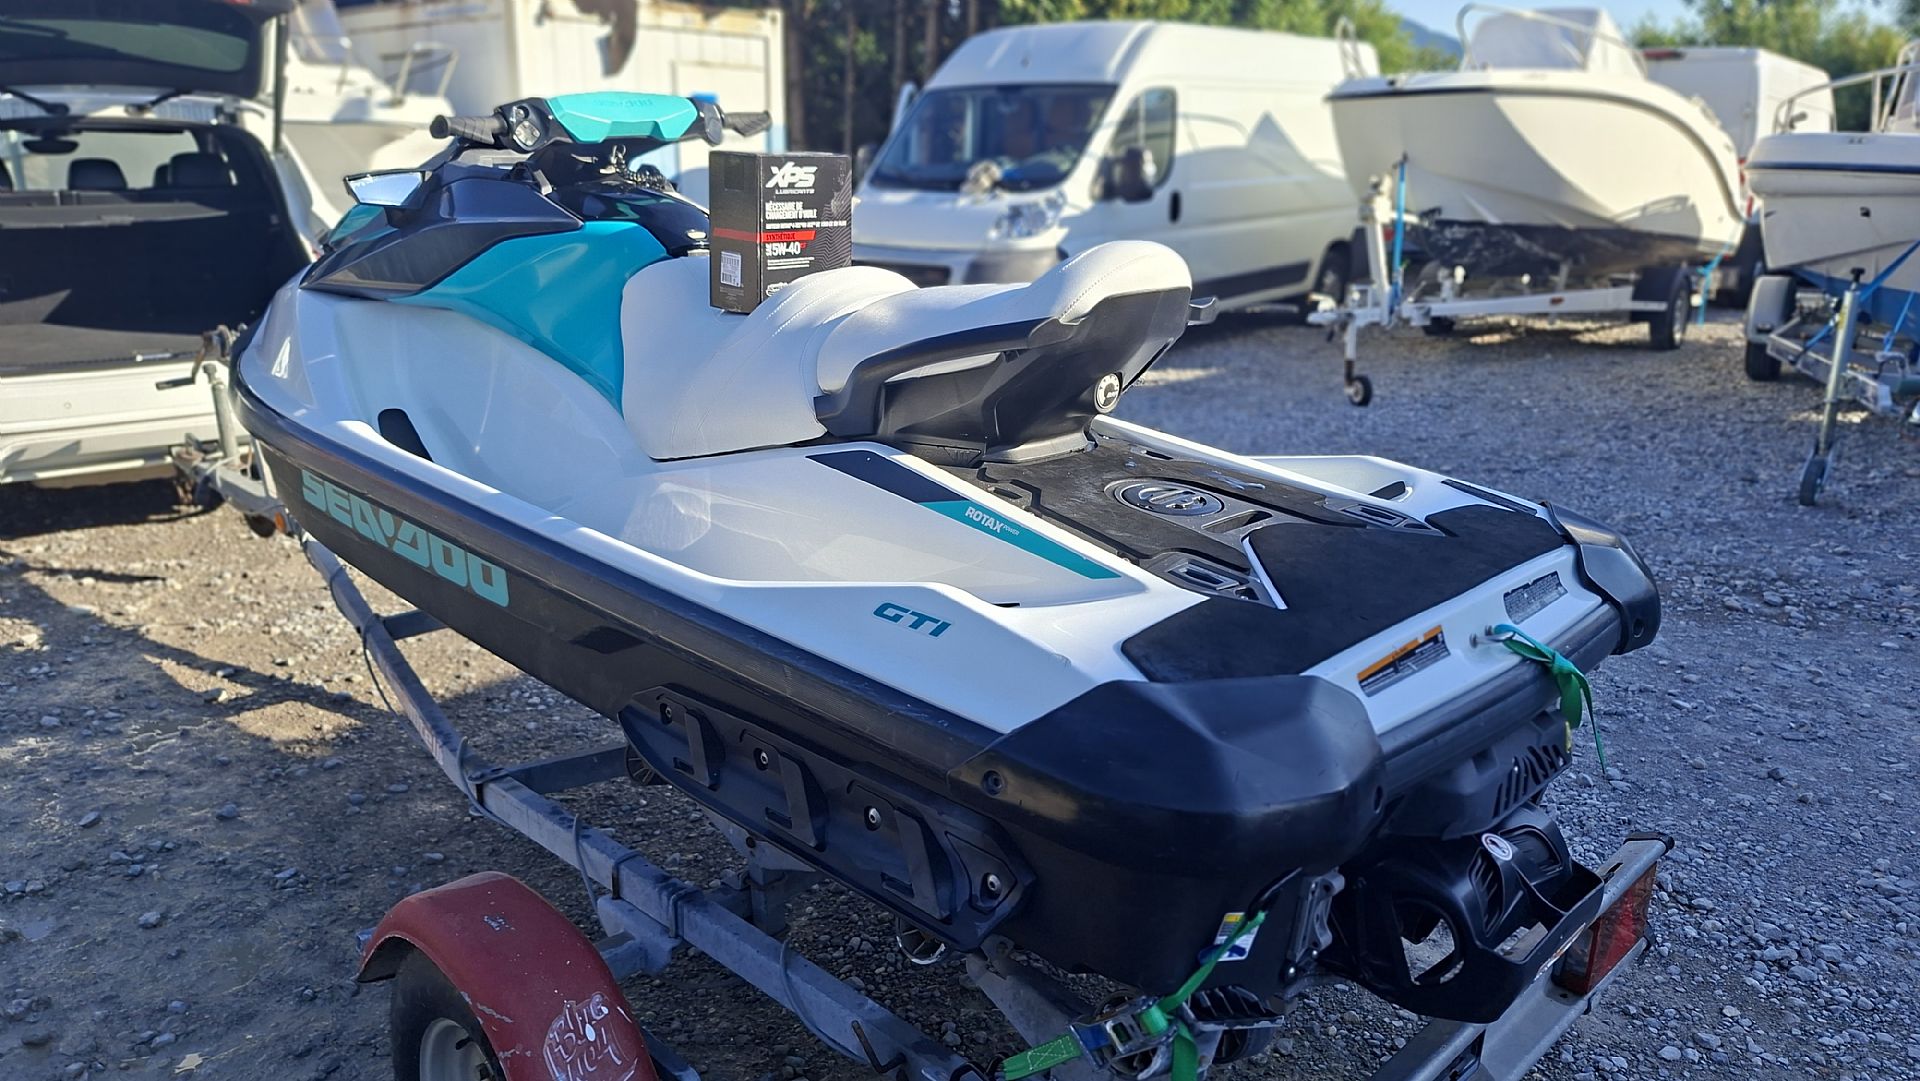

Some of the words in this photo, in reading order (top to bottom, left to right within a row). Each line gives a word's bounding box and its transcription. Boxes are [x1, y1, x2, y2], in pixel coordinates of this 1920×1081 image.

[765, 161, 818, 188] XPS
[772, 241, 801, 256] 5W-40
[965, 506, 1004, 534] ROTAX
[872, 602, 952, 638] GTI
